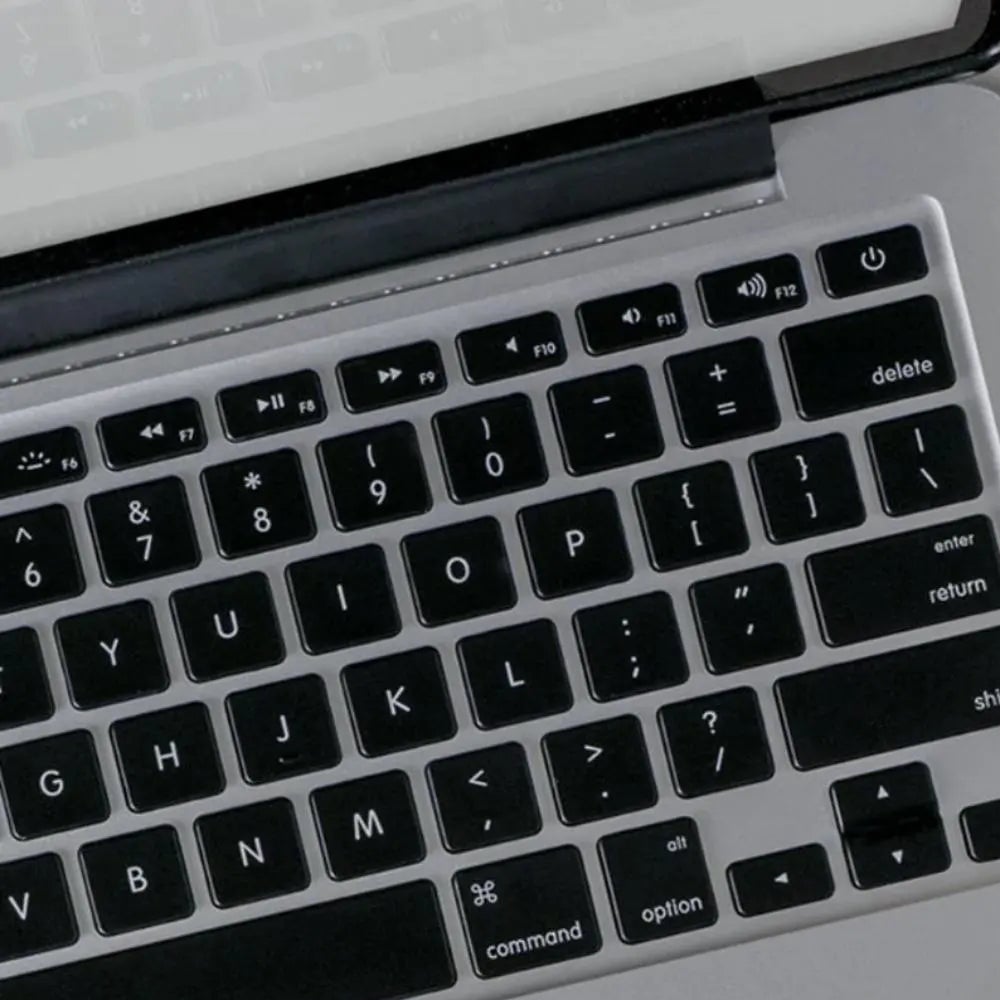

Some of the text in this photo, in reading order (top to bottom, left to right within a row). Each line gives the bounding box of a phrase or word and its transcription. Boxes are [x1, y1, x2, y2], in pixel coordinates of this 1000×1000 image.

[775, 284, 797, 299] F12
[657, 313, 676, 326] F11
[533, 342, 556, 357] F10
[419, 371, 435, 385] F9
[872, 359, 933, 385] delete
[179, 428, 194, 442] F7
[61, 457, 78, 470] F6
[369, 479, 387, 505] 9
[129, 500, 151, 525] &
[253, 507, 271, 533] 8
[136, 534, 153, 561] 7
[565, 529, 585, 557] P
[934, 534, 974, 553] enter
[24, 562, 41, 588] 6
[445, 556, 470, 584] O
[929, 578, 987, 604] return
[213, 610, 239, 639] U
[99, 638, 119, 666] Y
[504, 661, 525, 687] L
[386, 686, 411, 716] K
[277, 714, 290, 742] J
[702, 710, 718, 734] ?
[154, 741, 180, 771] H
[39, 769, 64, 797] G
[353, 809, 384, 841] M
[238, 837, 265, 867] N
[667, 836, 687, 852] alt
[126, 865, 148, 893] B
[8, 892, 30, 921] V
[641, 897, 703, 924] option
[486, 920, 583, 961] command
